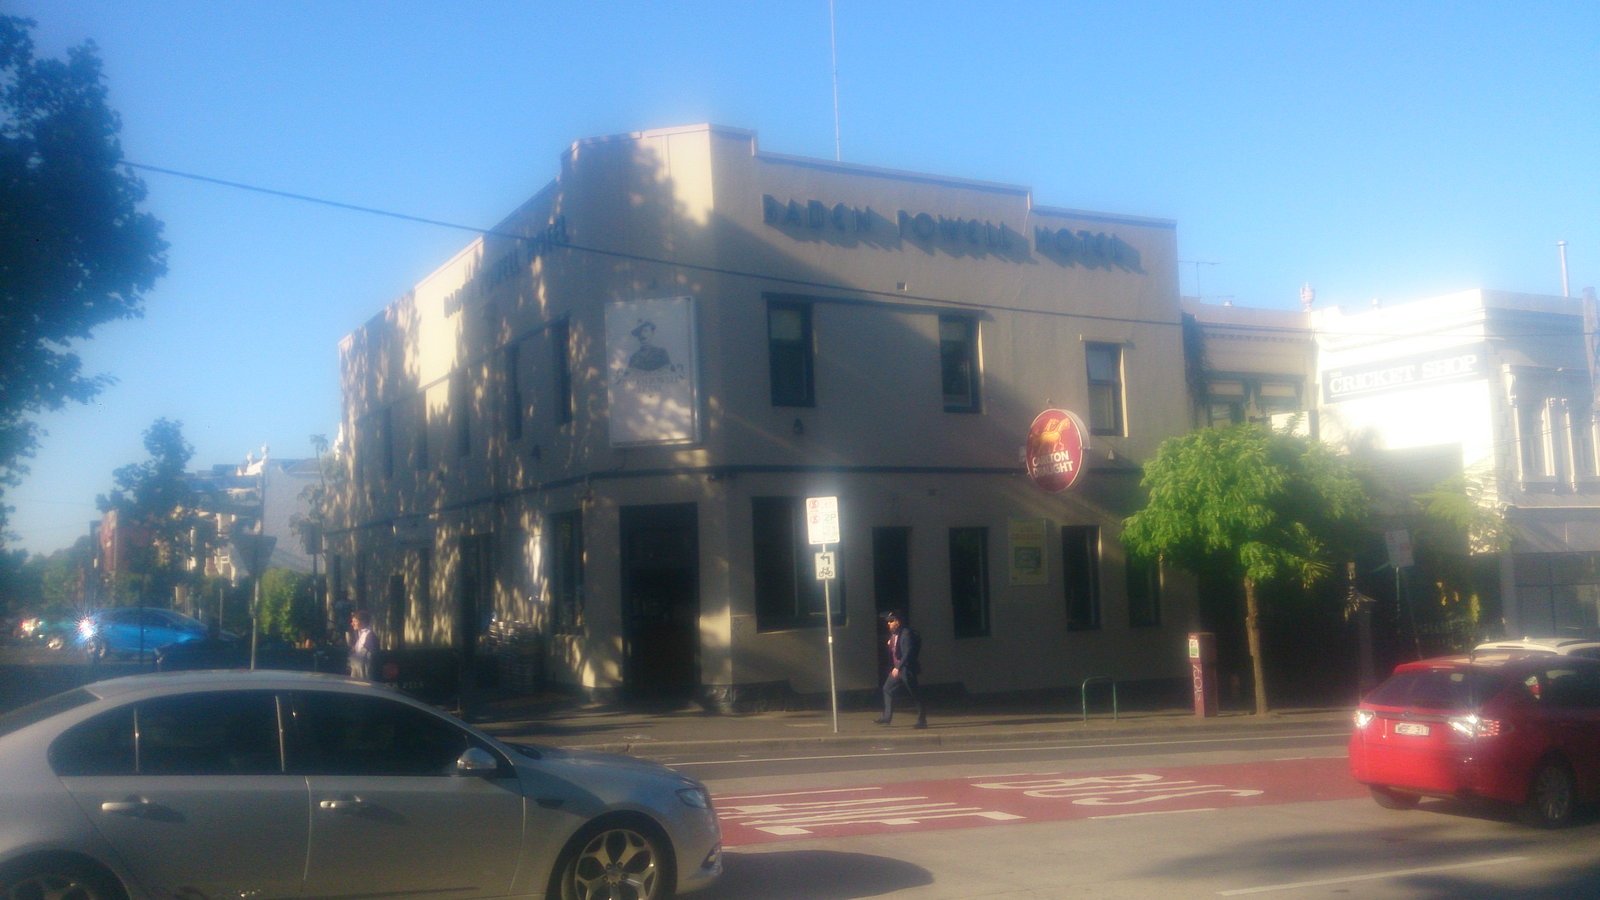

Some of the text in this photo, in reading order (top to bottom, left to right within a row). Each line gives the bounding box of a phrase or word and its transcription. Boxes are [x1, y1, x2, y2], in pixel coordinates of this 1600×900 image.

[1329, 354, 1478, 394] CRICKET SHOP
[1032, 460, 1073, 477] DGHT
[970, 773, 1264, 806] BUS
